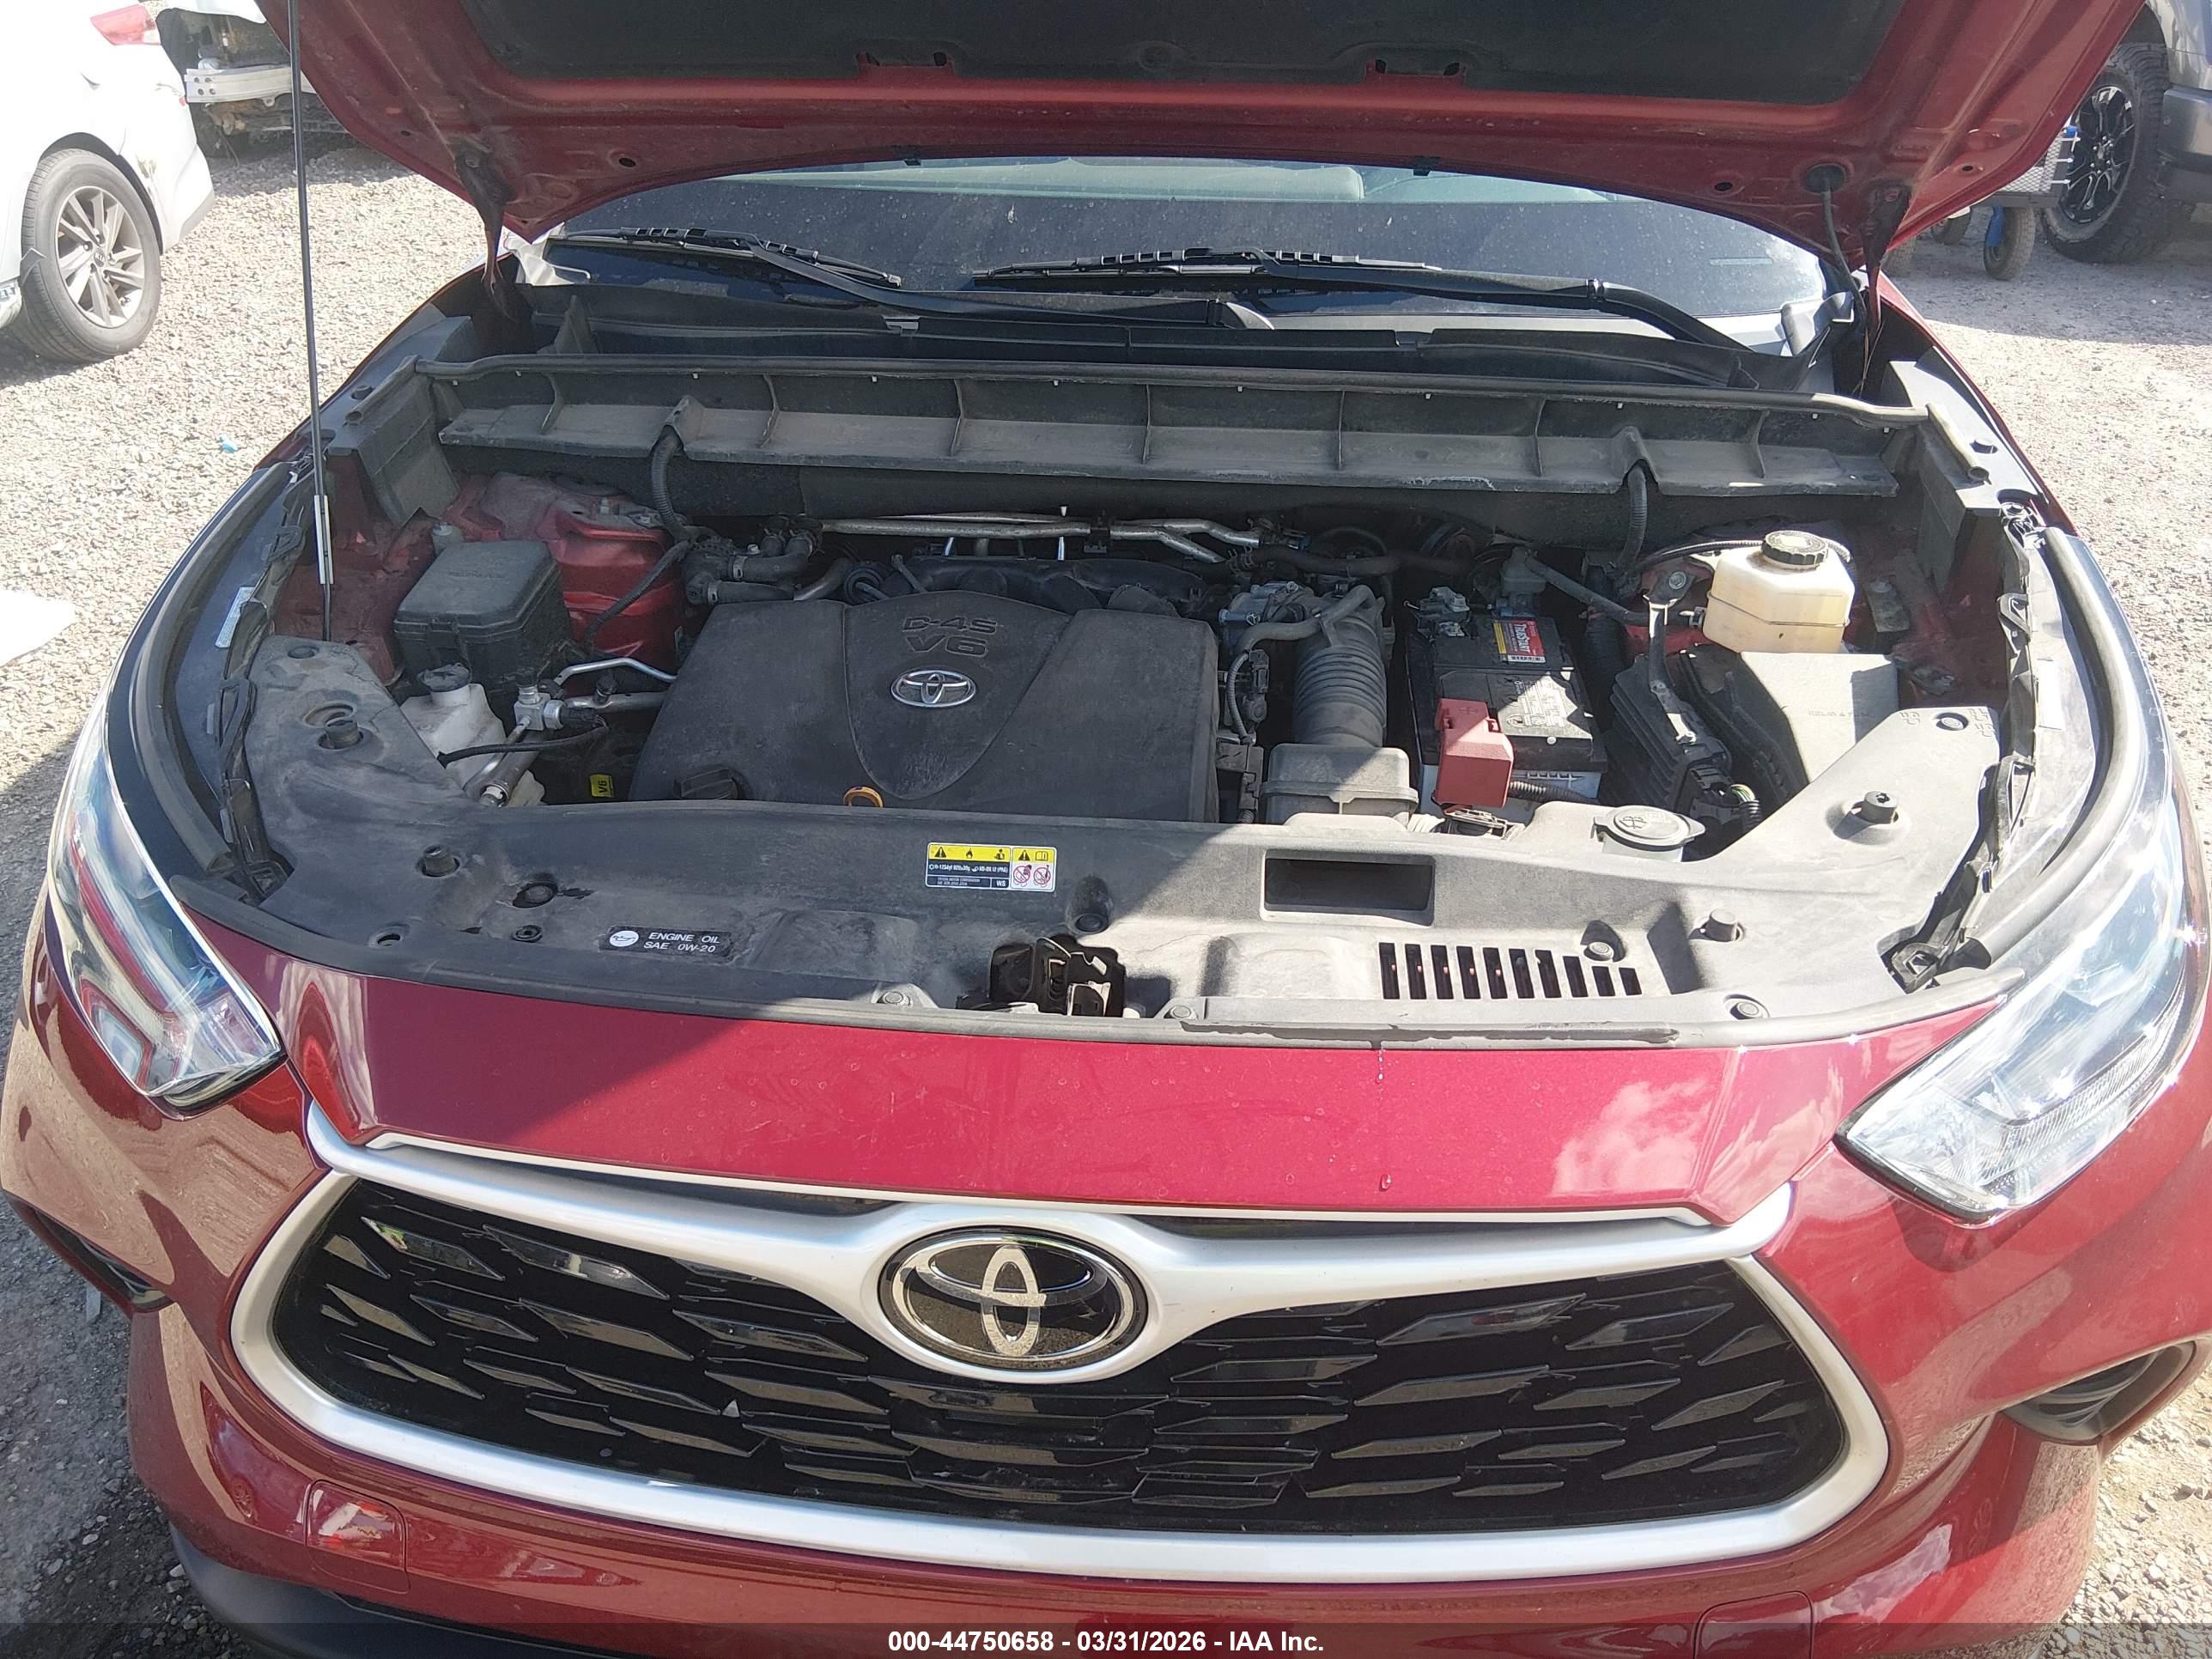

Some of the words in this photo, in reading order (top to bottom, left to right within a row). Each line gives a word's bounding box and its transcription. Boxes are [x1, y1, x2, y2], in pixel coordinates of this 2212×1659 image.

[902, 616, 997, 635] D-4S
[906, 634, 988, 658] V6
[648, 932, 695, 942] ENGINE
[701, 935, 720, 944] OIL
[644, 941, 671, 950] SAE
[678, 943, 716, 953] 0W-20
